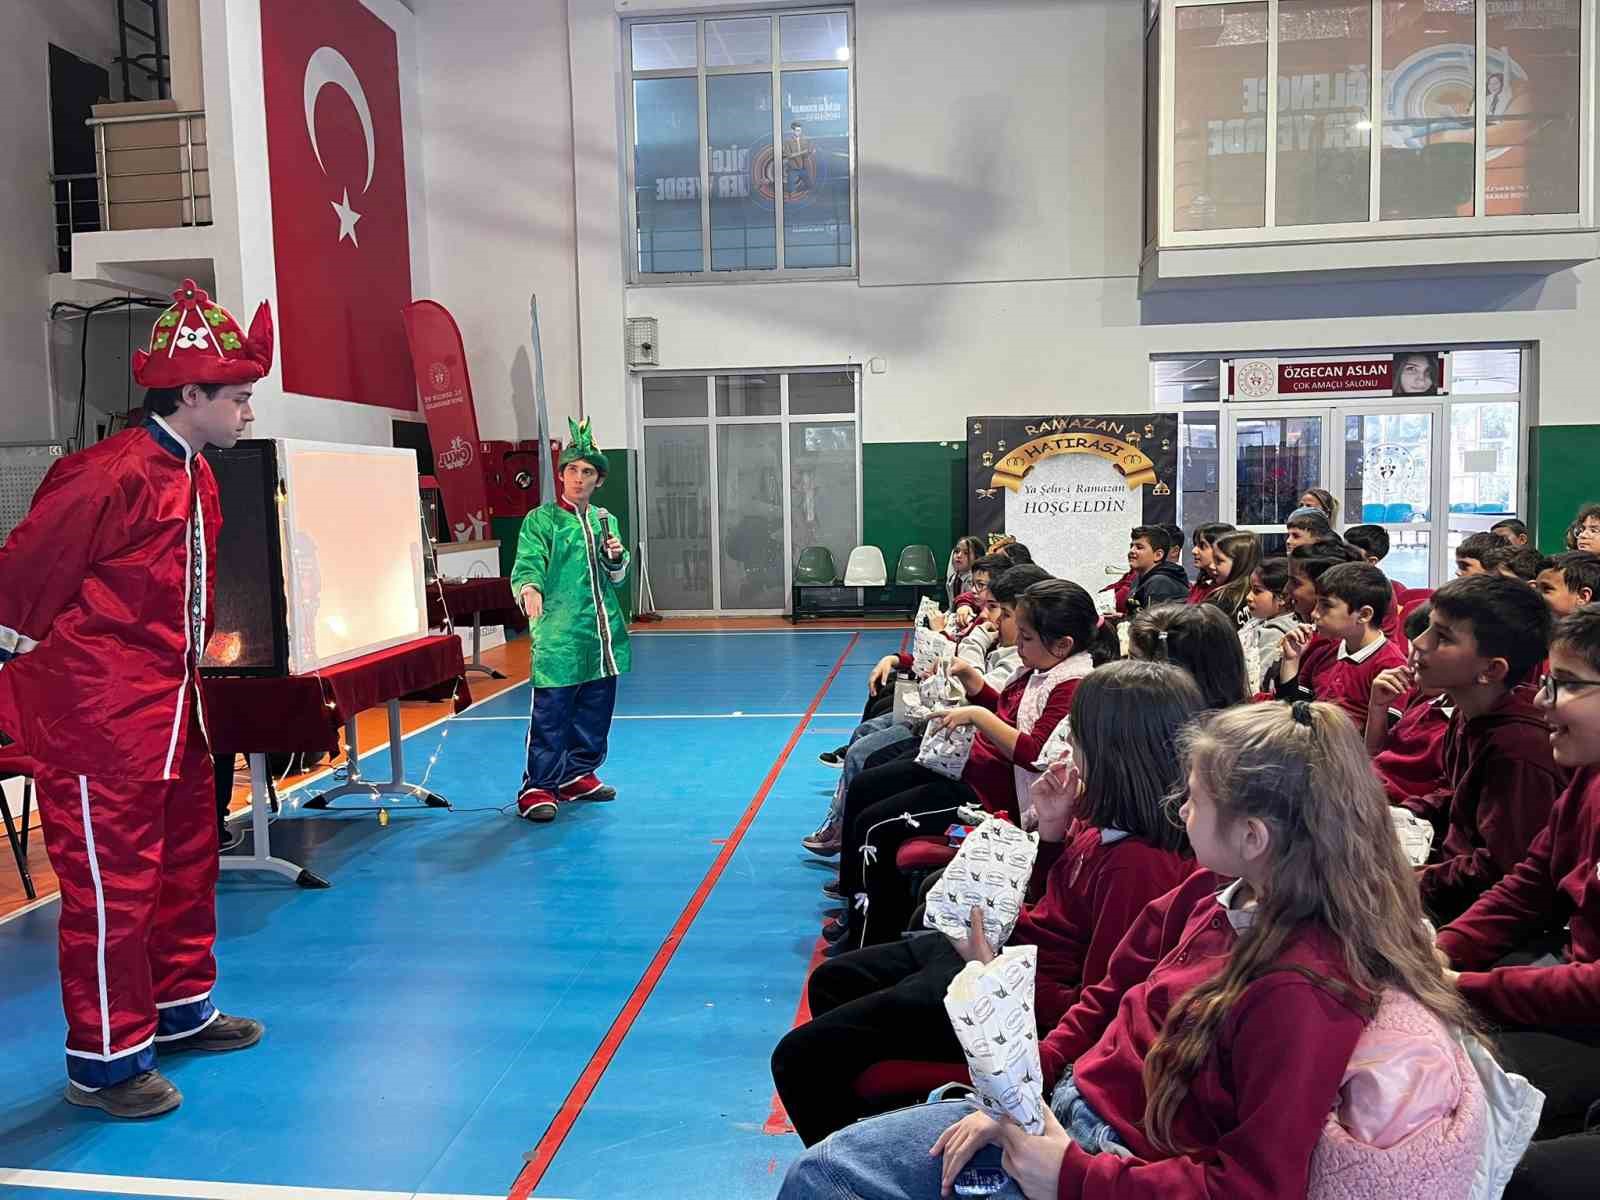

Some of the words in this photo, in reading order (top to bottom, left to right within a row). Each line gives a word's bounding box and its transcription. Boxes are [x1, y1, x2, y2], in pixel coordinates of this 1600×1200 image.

[1284, 366, 1343, 379] ÖZGECAN
[1347, 364, 1388, 376] ASLAN
[1293, 382, 1310, 391] ÇOK
[1344, 379, 1378, 388] SALONU
[1024, 418, 1124, 436] RAMAZAN
[1024, 437, 1124, 459] HATIRASI
[1025, 484, 1037, 494] Ya
[1076, 484, 1125, 493] Ramazan
[1024, 497, 1125, 517] HOŞGELDİN
